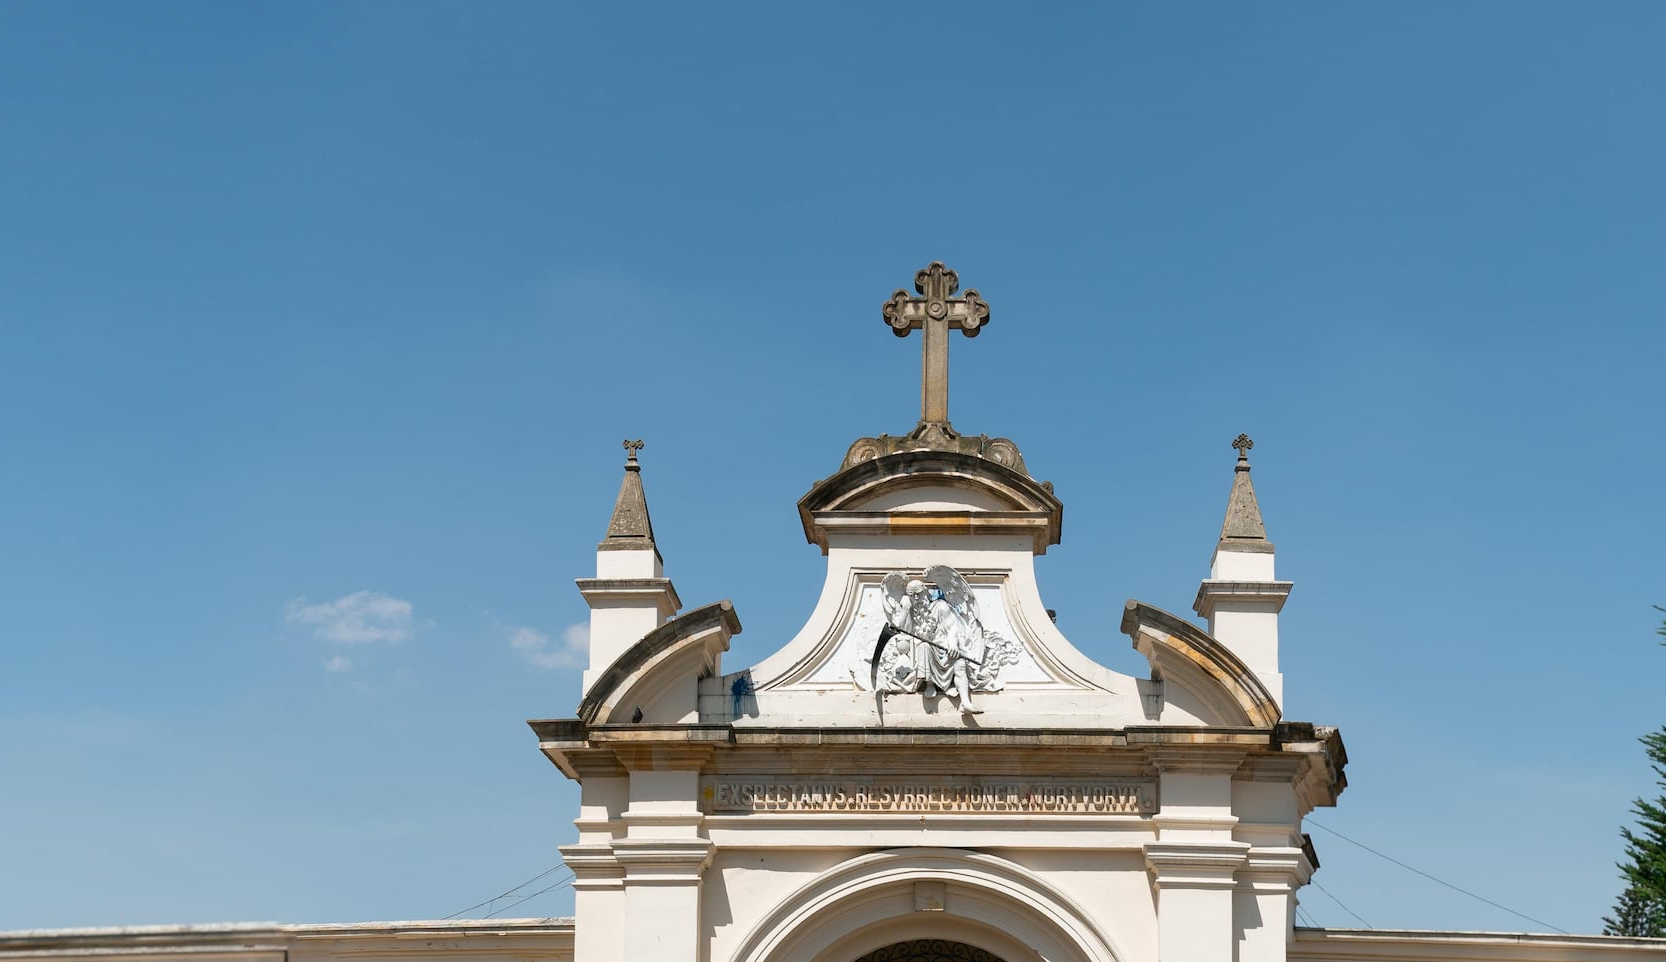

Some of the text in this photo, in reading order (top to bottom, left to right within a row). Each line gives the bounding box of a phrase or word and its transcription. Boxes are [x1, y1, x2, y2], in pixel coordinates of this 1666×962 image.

[717, 783, 1141, 806] EXSPECTAMVS RESVRRECTIONEM MORTVORVM
